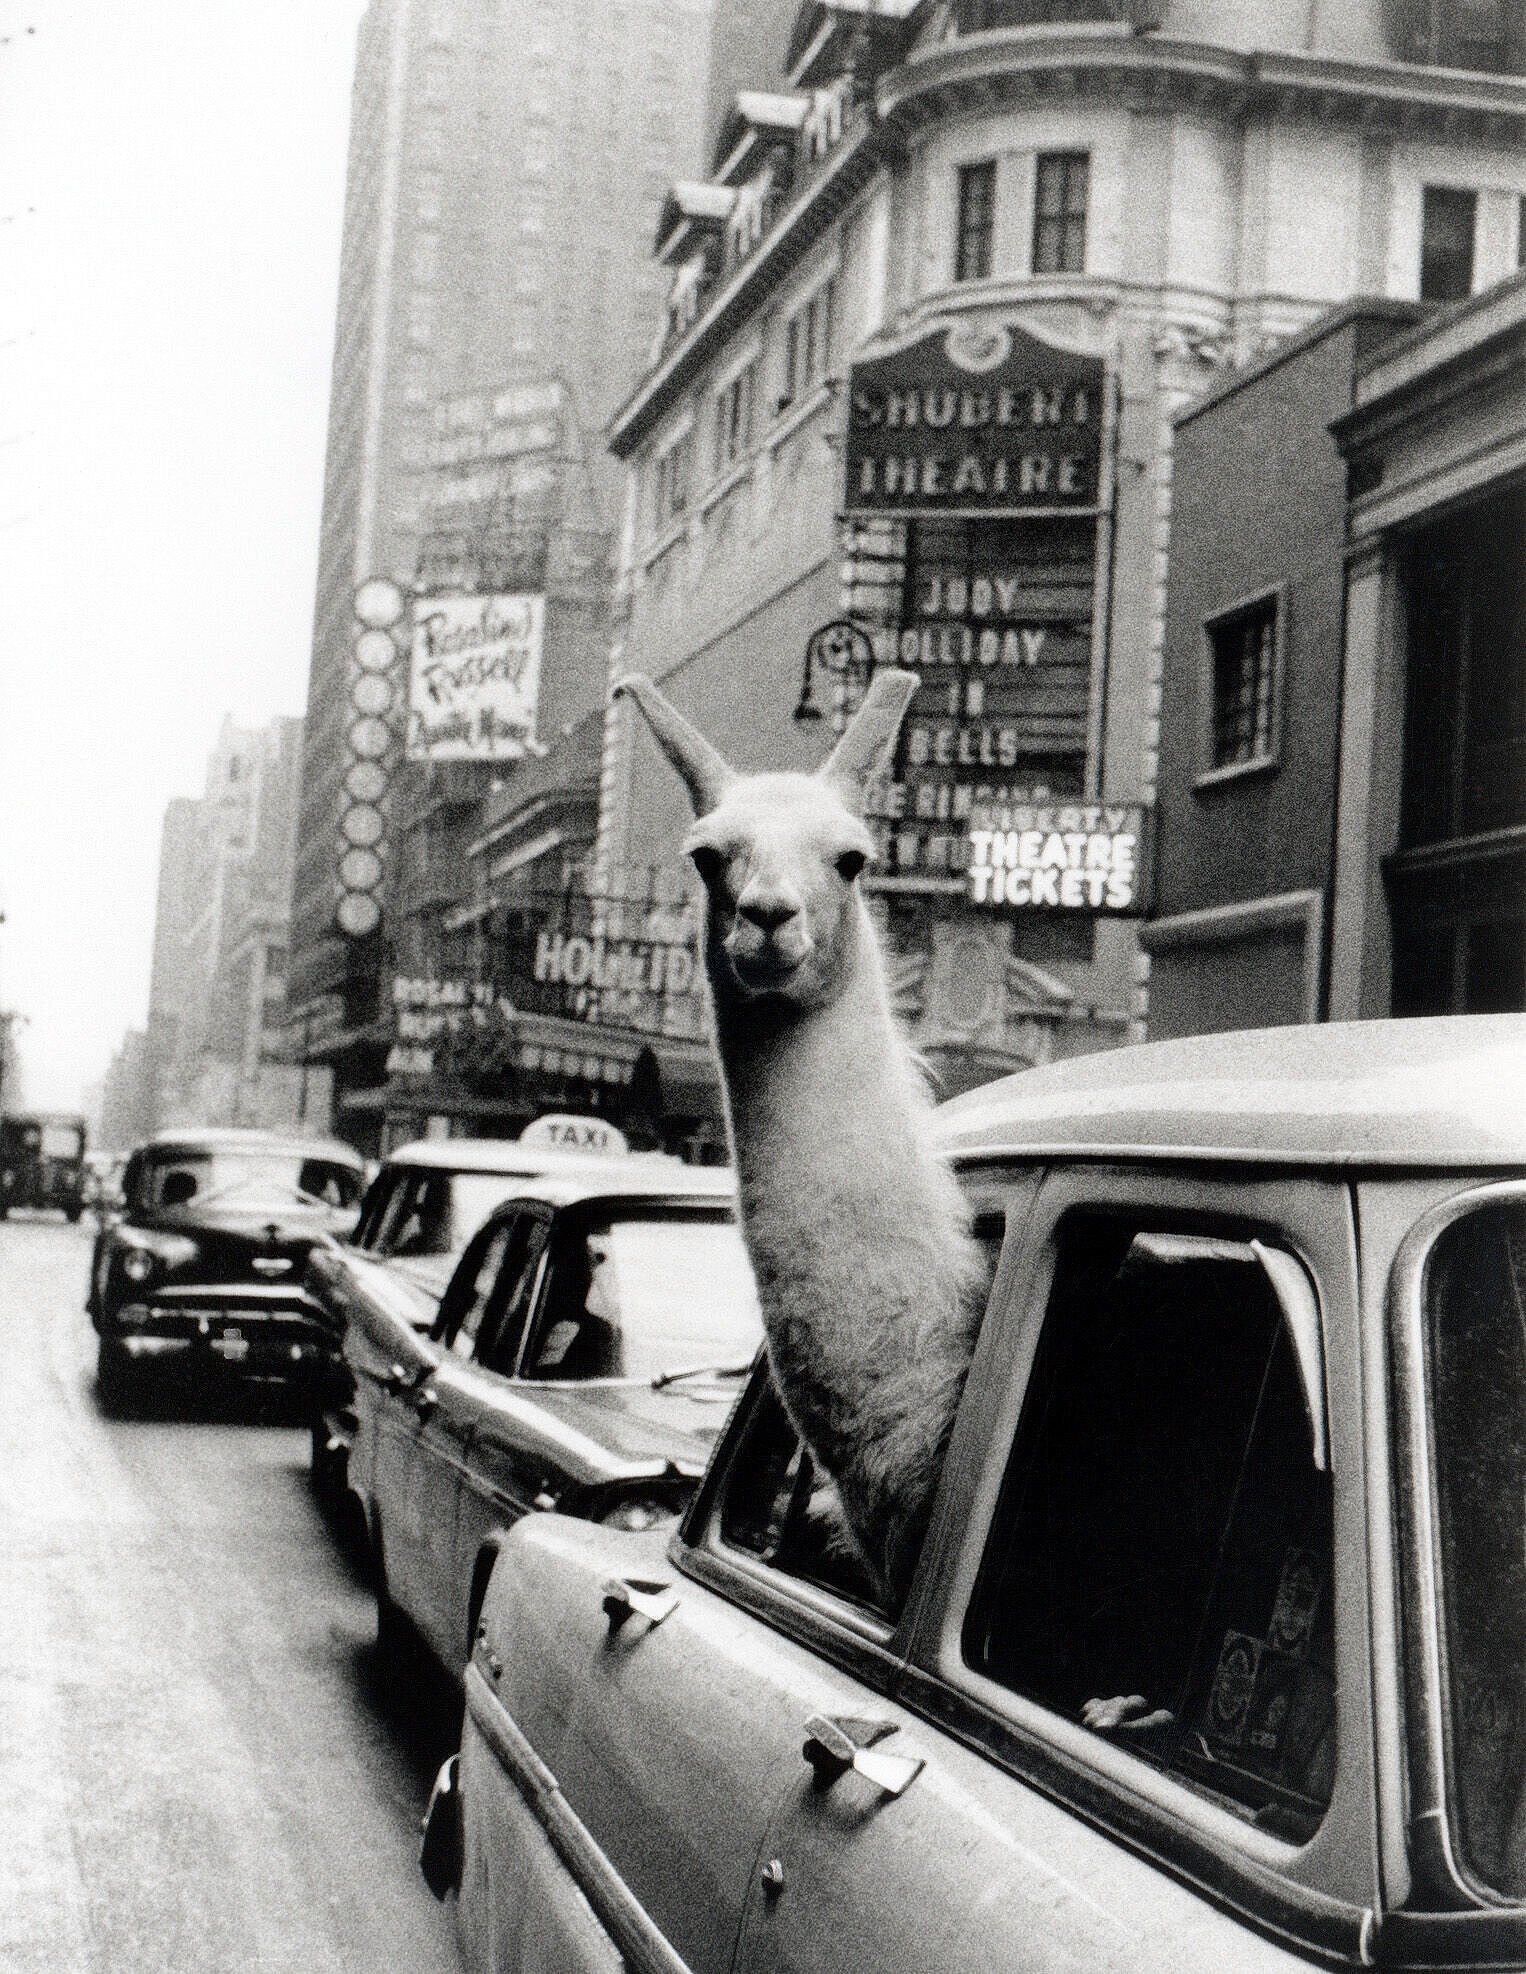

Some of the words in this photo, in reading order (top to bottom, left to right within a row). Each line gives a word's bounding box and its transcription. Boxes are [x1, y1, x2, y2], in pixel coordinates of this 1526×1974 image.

[855, 388, 1092, 427] SHUBERT
[857, 455, 1086, 496] THEATRE
[921, 578, 1018, 616] JUDY
[908, 729, 1017, 767] BELLS
[969, 830, 1136, 871] THEATRE
[969, 865, 1133, 908] TICKETS
[546, 1122, 609, 1148] TAXI
